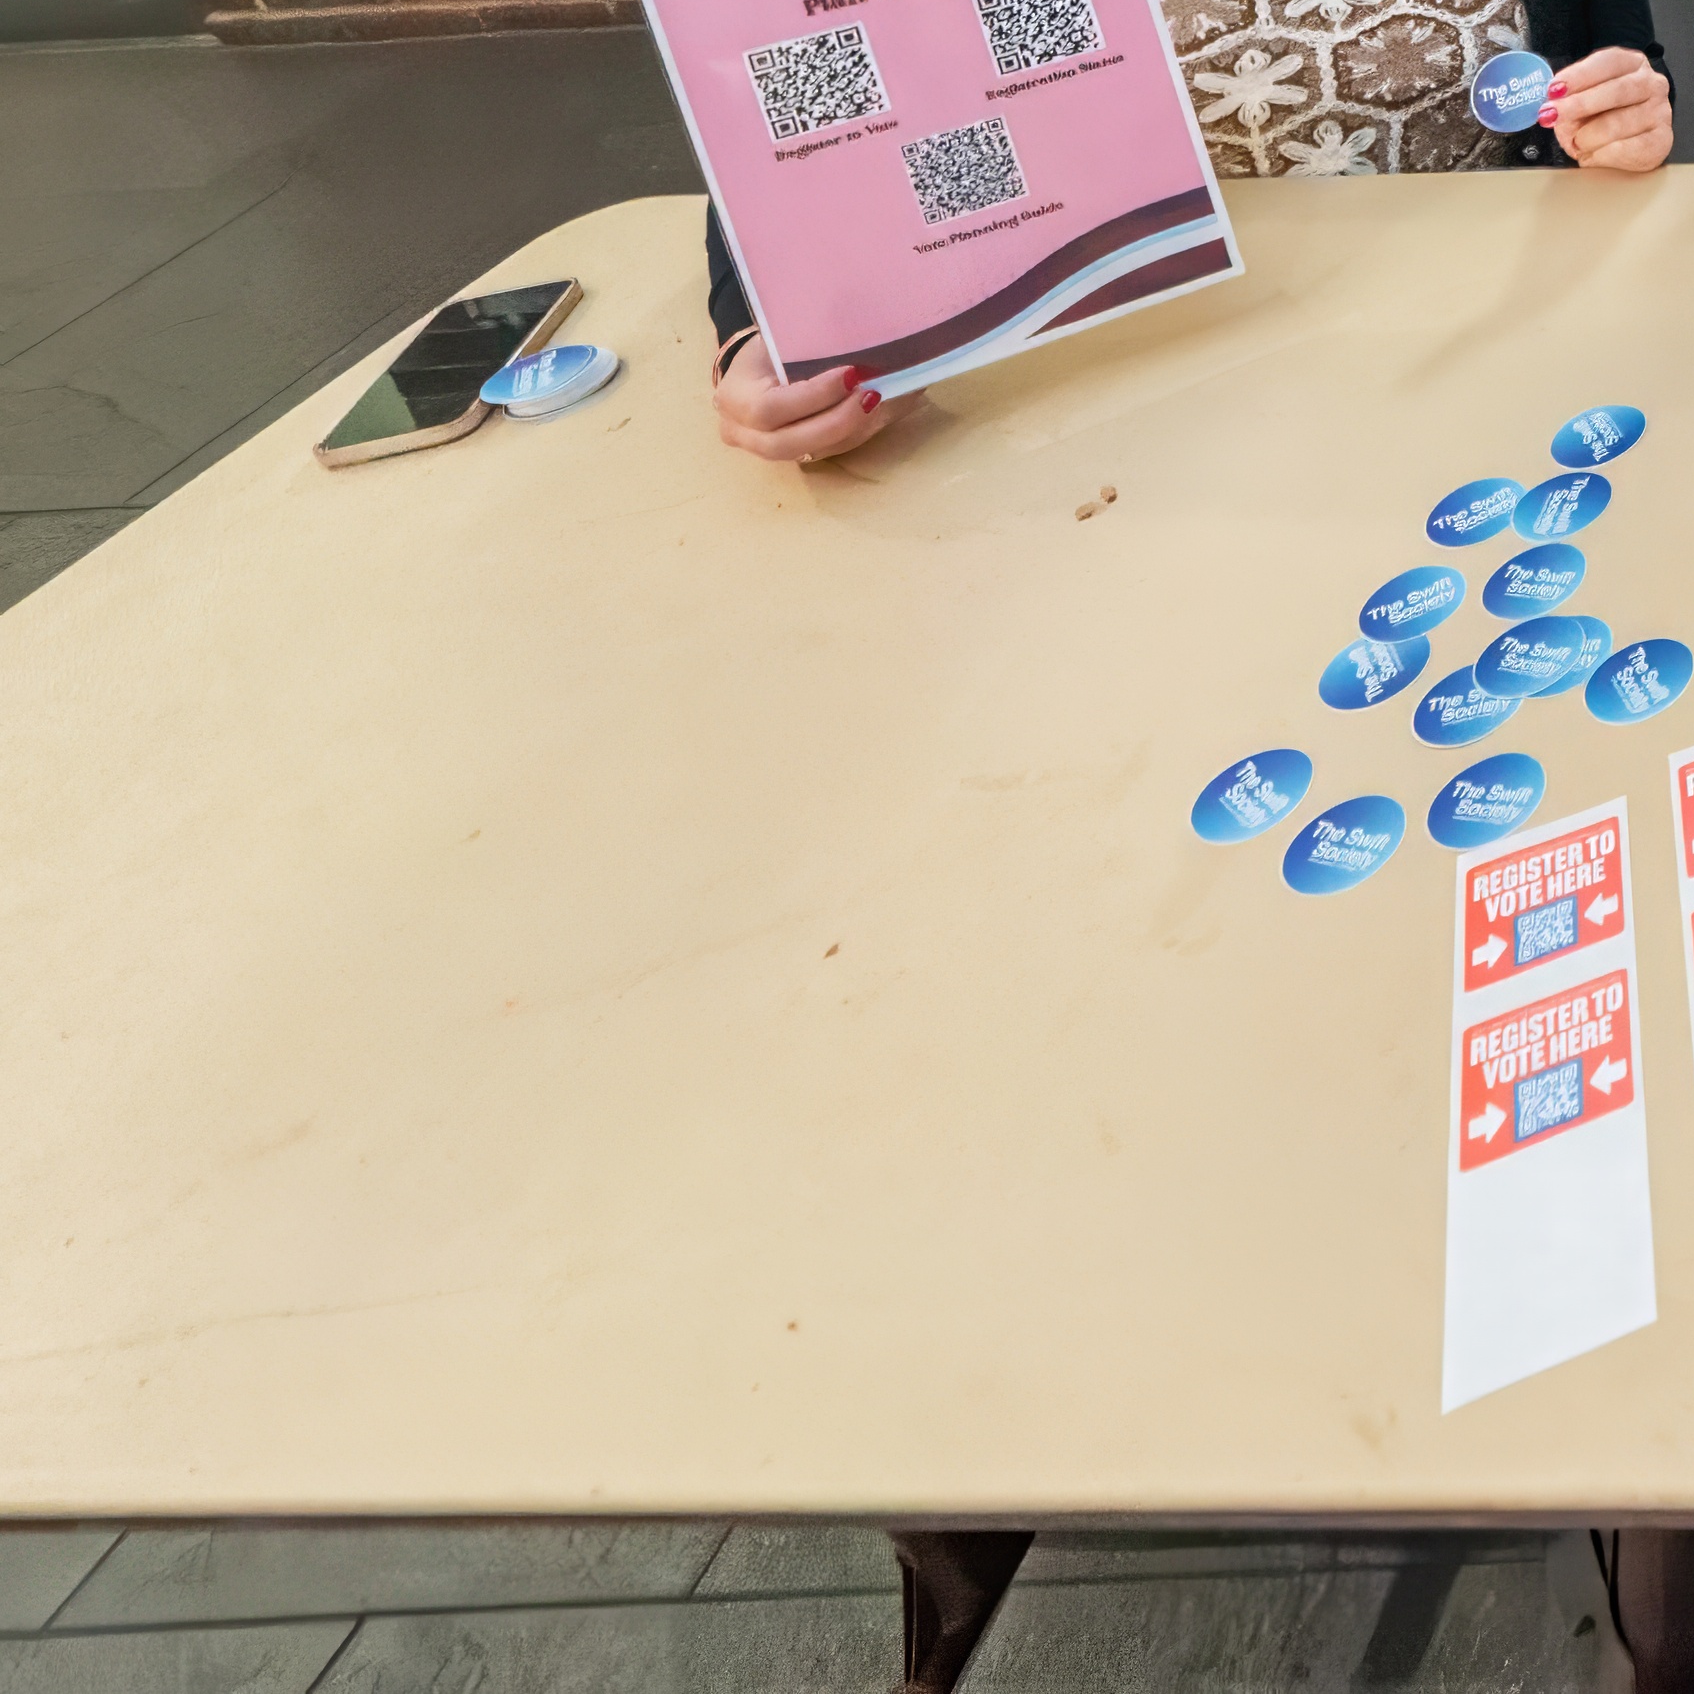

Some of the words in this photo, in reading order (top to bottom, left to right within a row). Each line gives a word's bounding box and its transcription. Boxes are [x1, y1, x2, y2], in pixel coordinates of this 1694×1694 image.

[1473, 836, 1585, 903] REGISTER
[1586, 829, 1616, 858] TO
[1485, 879, 1547, 922] VOTE
[1547, 858, 1606, 909] HERE
[1469, 991, 1591, 1066] REGISTER
[1593, 982, 1624, 1016] TO
[1483, 1038, 1546, 1089] VOTE
[1545, 1017, 1613, 1065] HERE
